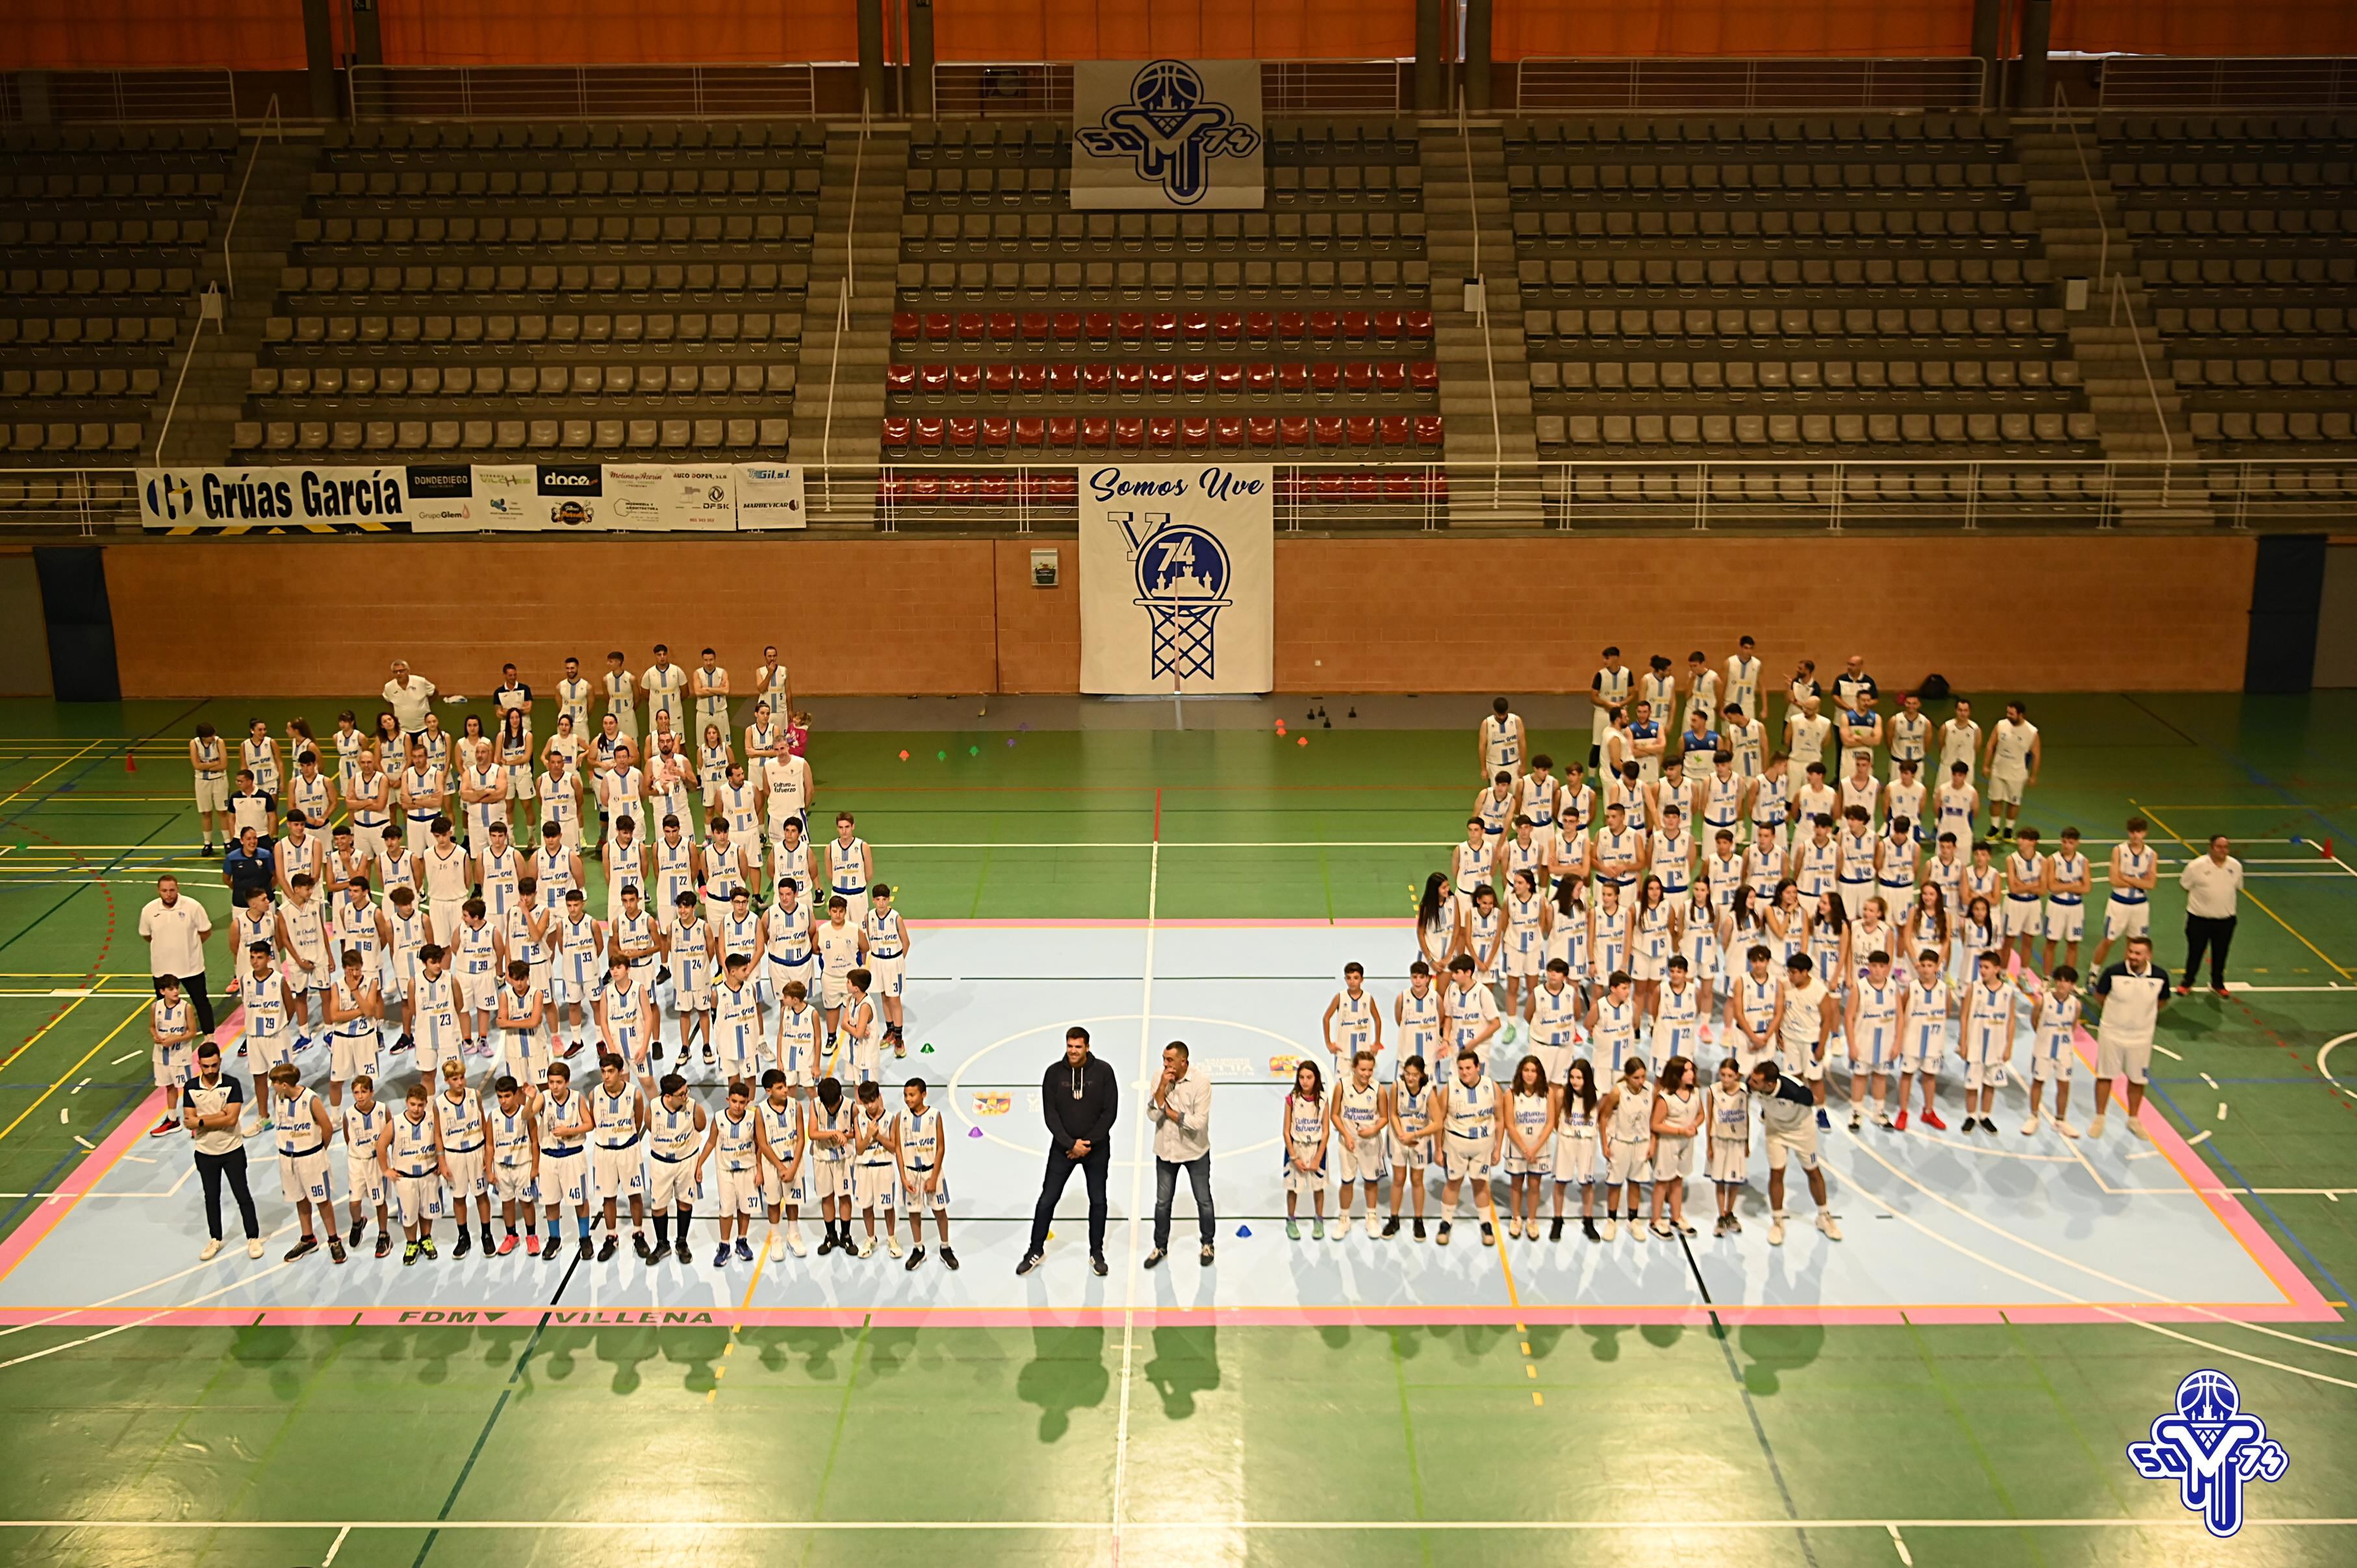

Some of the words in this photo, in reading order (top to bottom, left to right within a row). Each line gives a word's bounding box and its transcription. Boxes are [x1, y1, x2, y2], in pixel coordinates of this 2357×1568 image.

[414, 475, 468, 485] DONDEDIEGO
[544, 472, 590, 485] doce
[1089, 466, 1188, 502] Somos
[1199, 466, 1264, 501] Uve
[202, 473, 293, 518] Grúas
[301, 470, 403, 517] García
[1157, 536, 1195, 572] 74
[264, 769, 272, 778] 77
[679, 876, 687, 885] 22
[852, 877, 856, 885] 9
[505, 884, 513, 893] 39
[557, 888, 565, 897] 36
[530, 944, 539, 955] 35
[796, 948, 802, 958] 11
[583, 952, 592, 961] 33
[478, 961, 488, 970] 39
[692, 959, 702, 970] 24
[485, 996, 495, 1005] 39
[266, 1018, 275, 1028] 29
[440, 1014, 451, 1026] 23
[628, 1028, 635, 1037] 16
[745, 1024, 750, 1034] 5
[1425, 1032, 1433, 1041] 14
[798, 1046, 803, 1056] 4
[364, 1065, 376, 1074] 25
[538, 1069, 546, 1078] 17
[630, 1176, 641, 1187] 43
[311, 1185, 324, 1197] 96
[372, 1188, 380, 1200] 91
[791, 1188, 802, 1199] 28
[748, 1196, 758, 1208] 37
[881, 1193, 891, 1204] 26
[429, 1202, 440, 1213] 89
[398, 1311, 478, 1323] FDM
[555, 1312, 713, 1324] VILLENA
